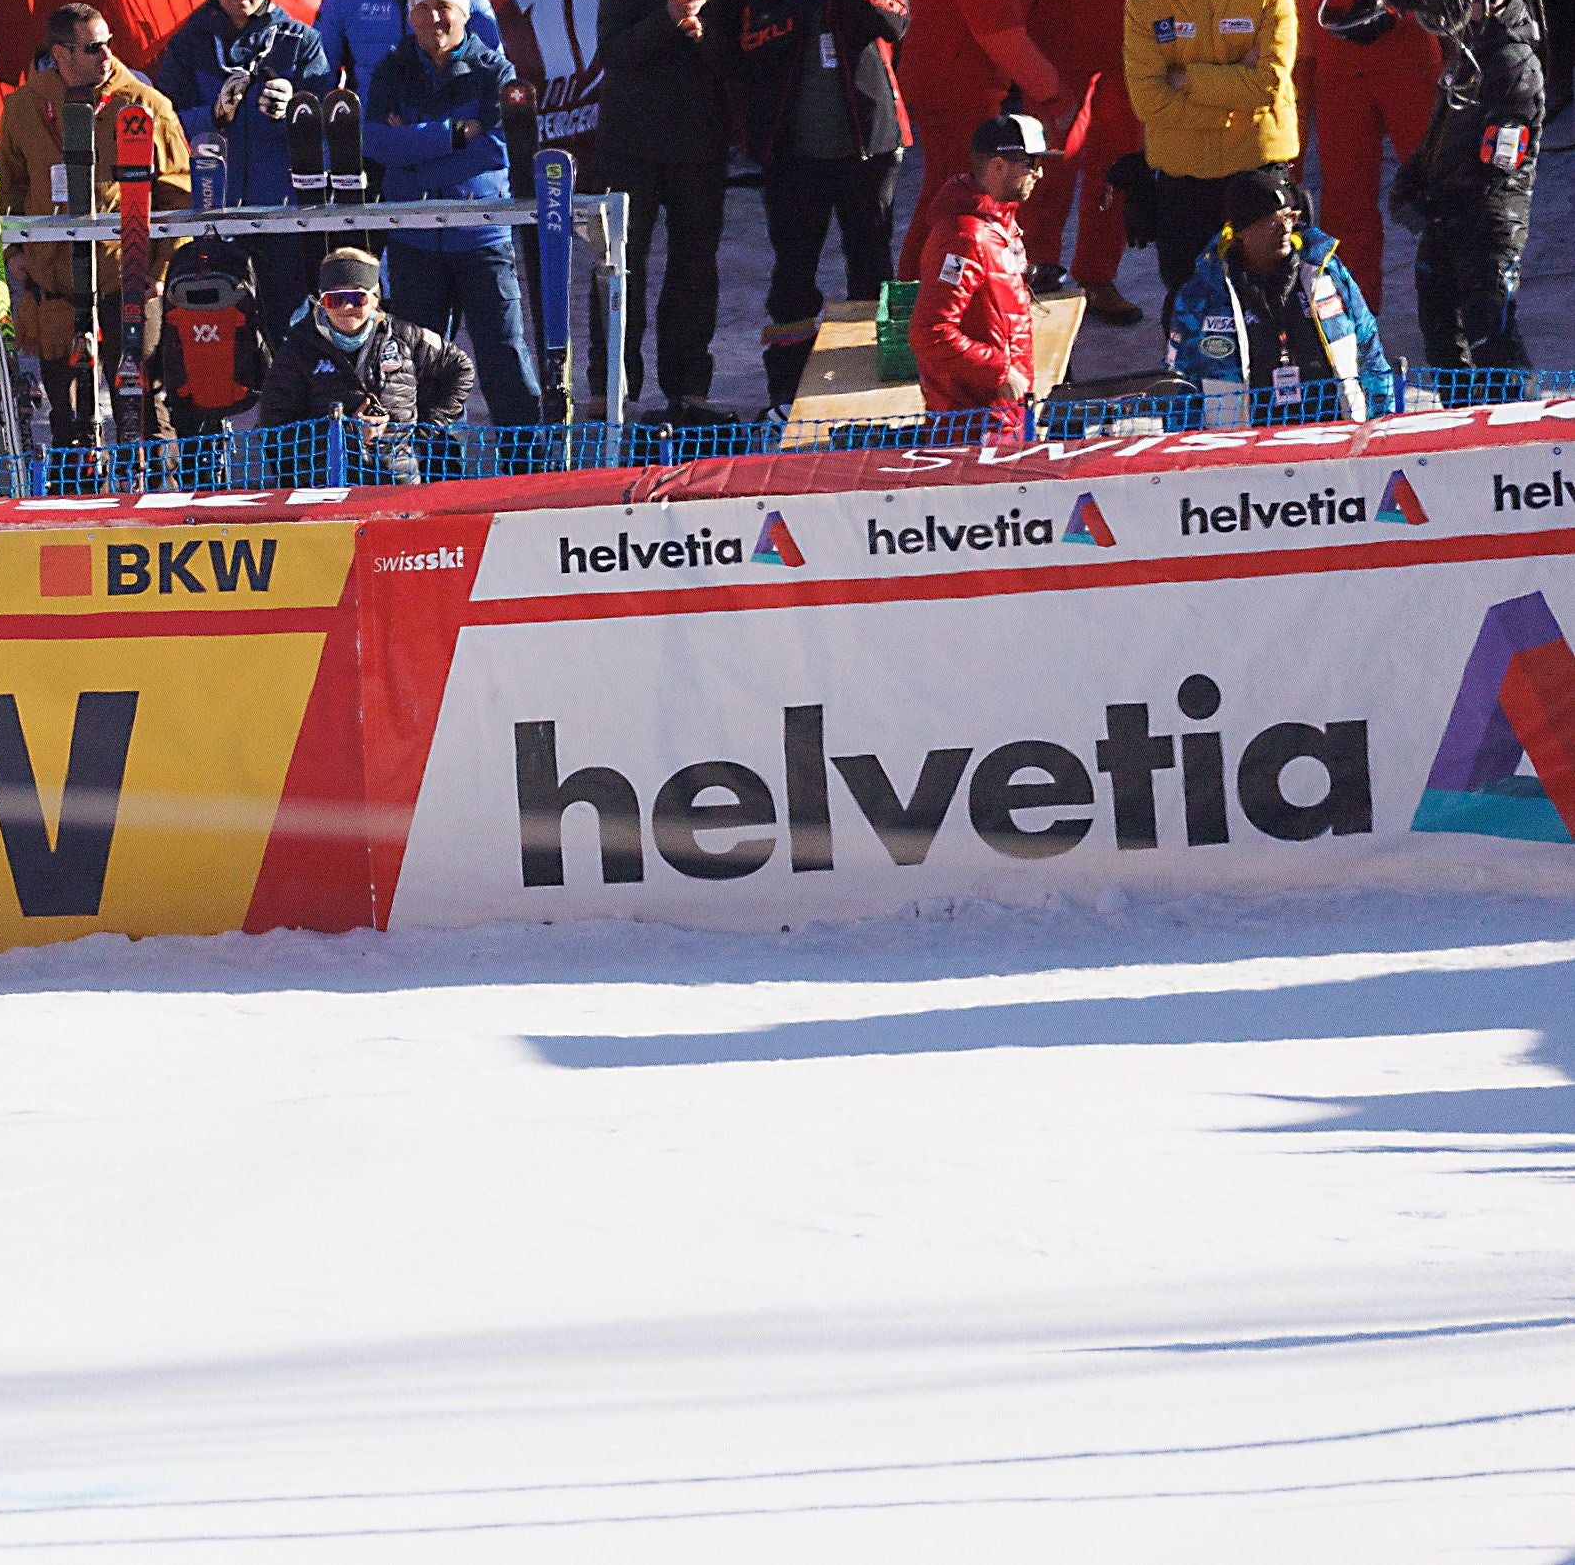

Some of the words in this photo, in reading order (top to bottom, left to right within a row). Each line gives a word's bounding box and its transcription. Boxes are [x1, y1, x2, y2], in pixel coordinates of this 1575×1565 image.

[1207, 318, 1236, 331] VISA
[868, 508, 1053, 555] helvetia
[1180, 487, 1367, 535] helvetia
[107, 539, 277, 596] BKW
[373, 545, 465, 574] swissski
[559, 527, 743, 574] helvetia
[513, 673, 1374, 889] helvetia
